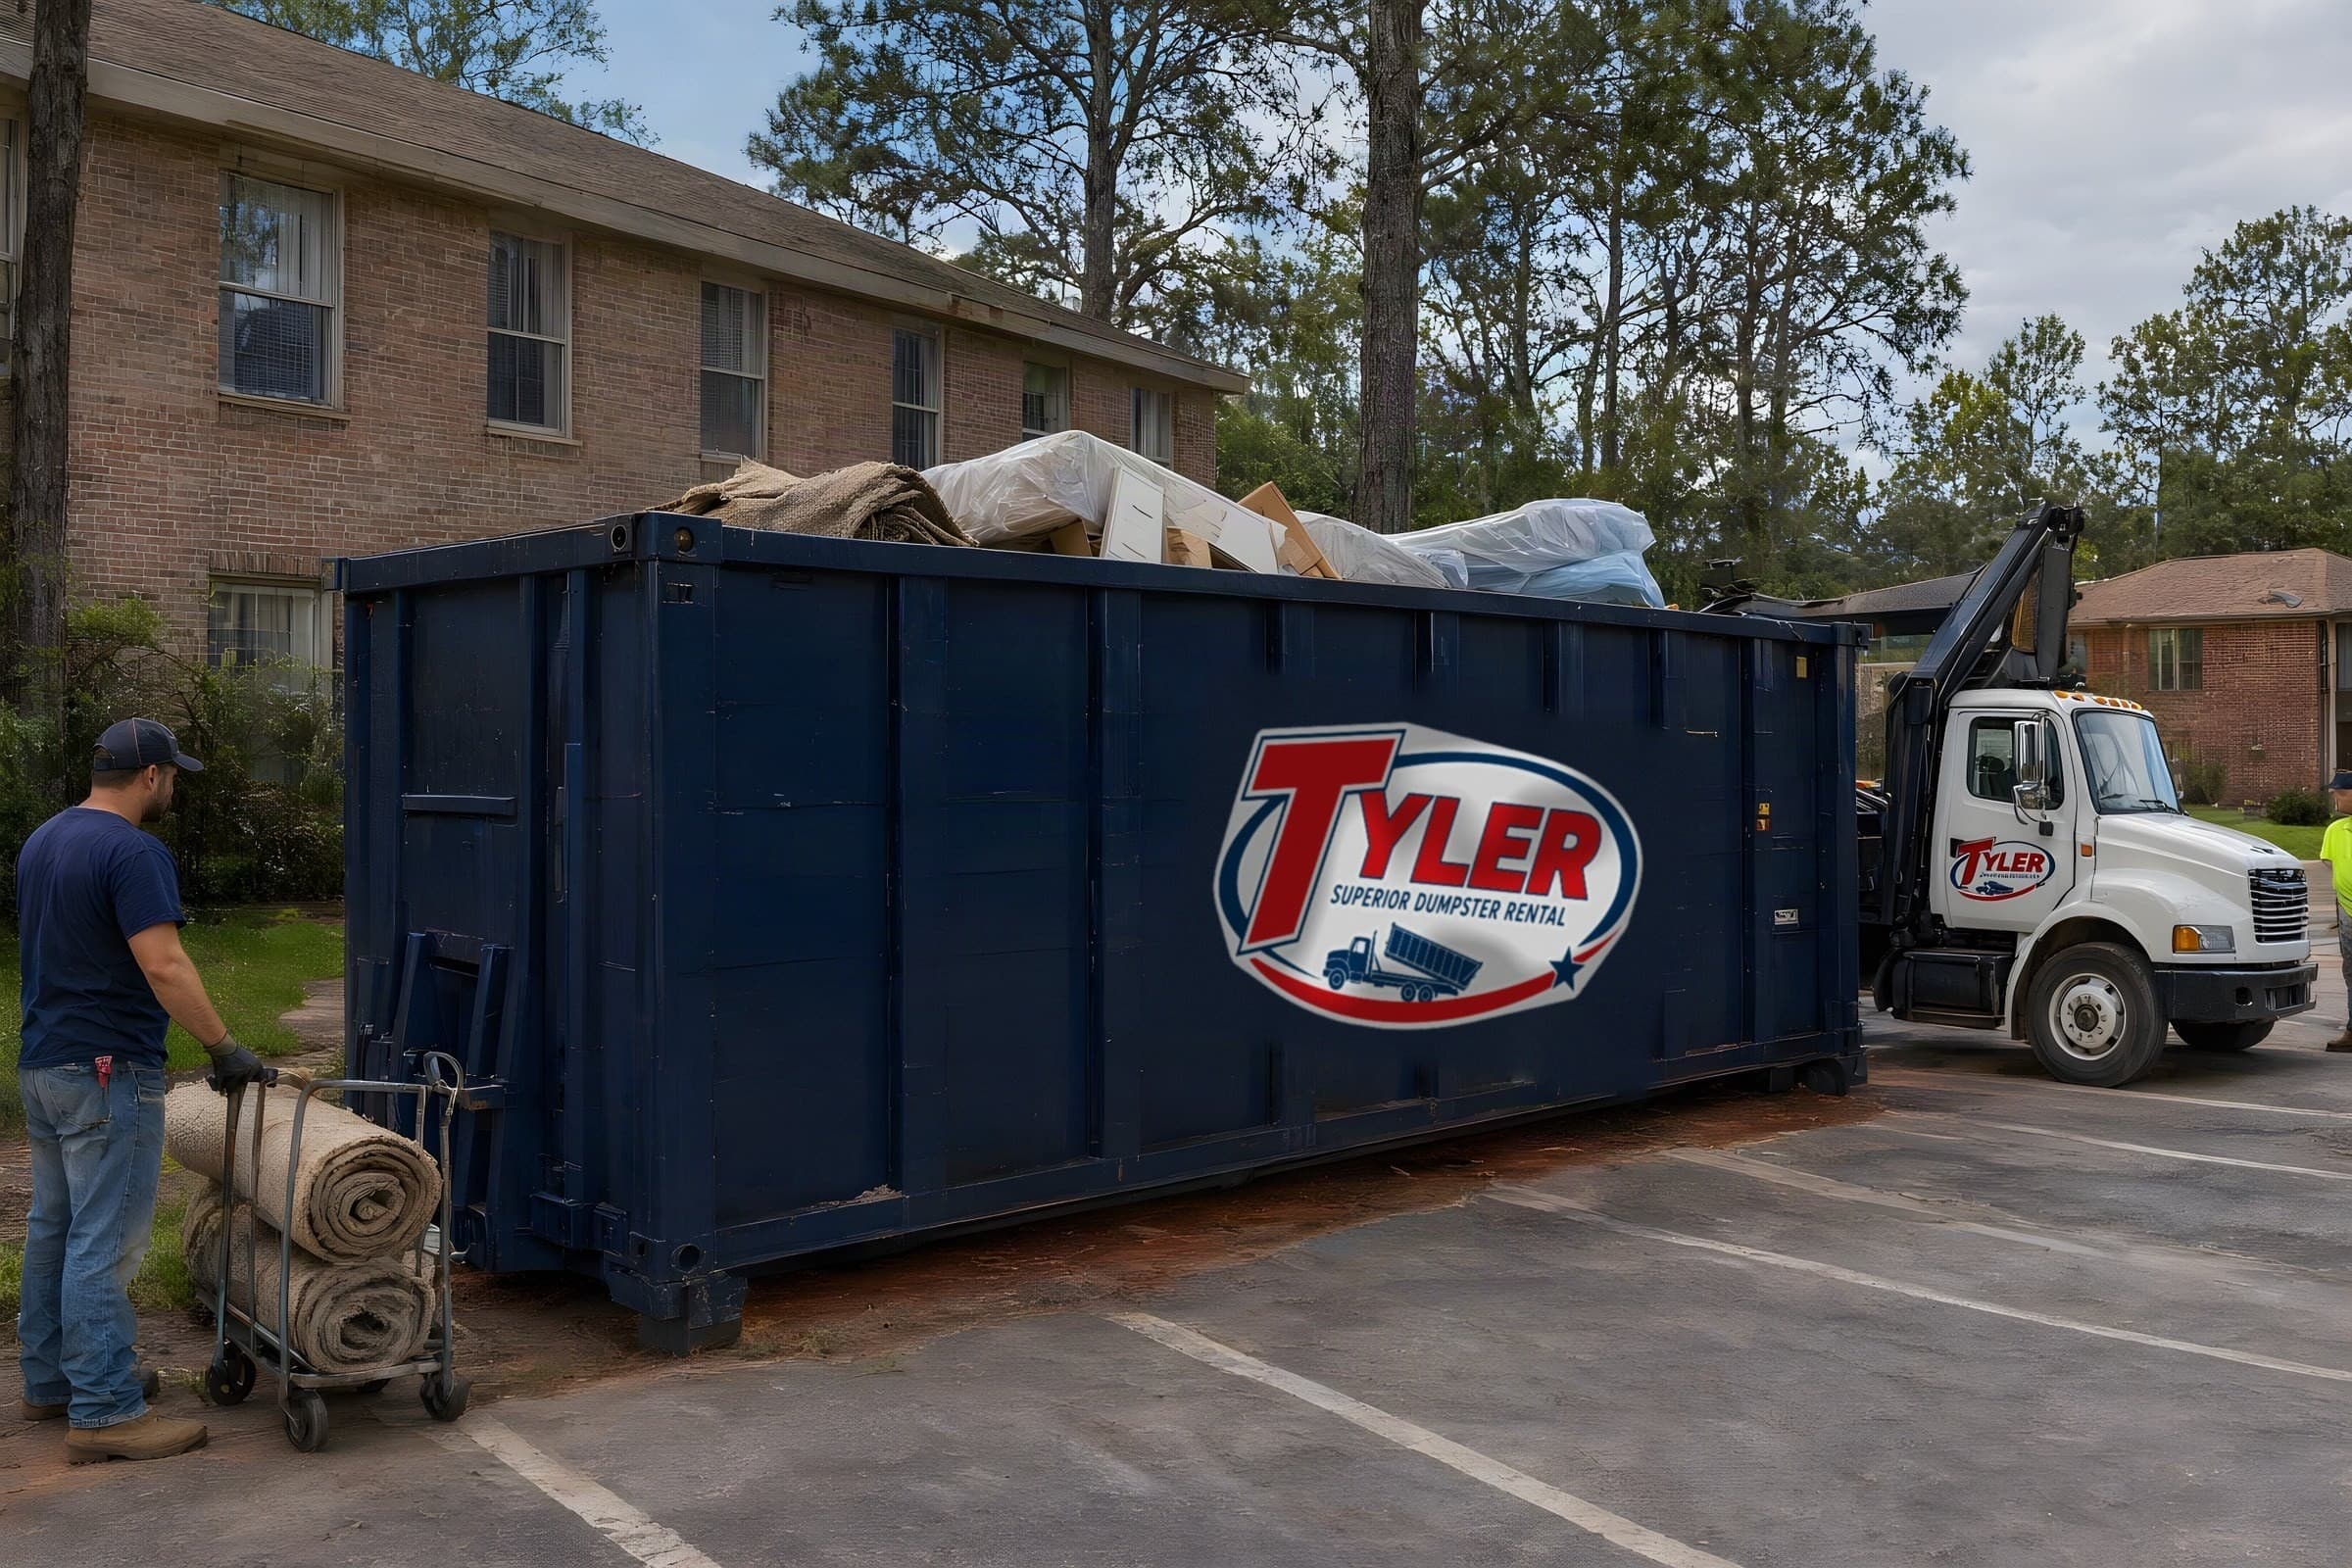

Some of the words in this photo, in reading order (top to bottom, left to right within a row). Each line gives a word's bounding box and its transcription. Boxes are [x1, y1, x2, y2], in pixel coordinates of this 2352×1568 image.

[1241, 733, 1602, 953] TYLER
[1957, 837, 2045, 885] TYLER
[1330, 884, 1410, 910] SUPERIOR
[1414, 891, 1501, 920] DUMPSTER
[1504, 900, 1566, 926] RENTAL
